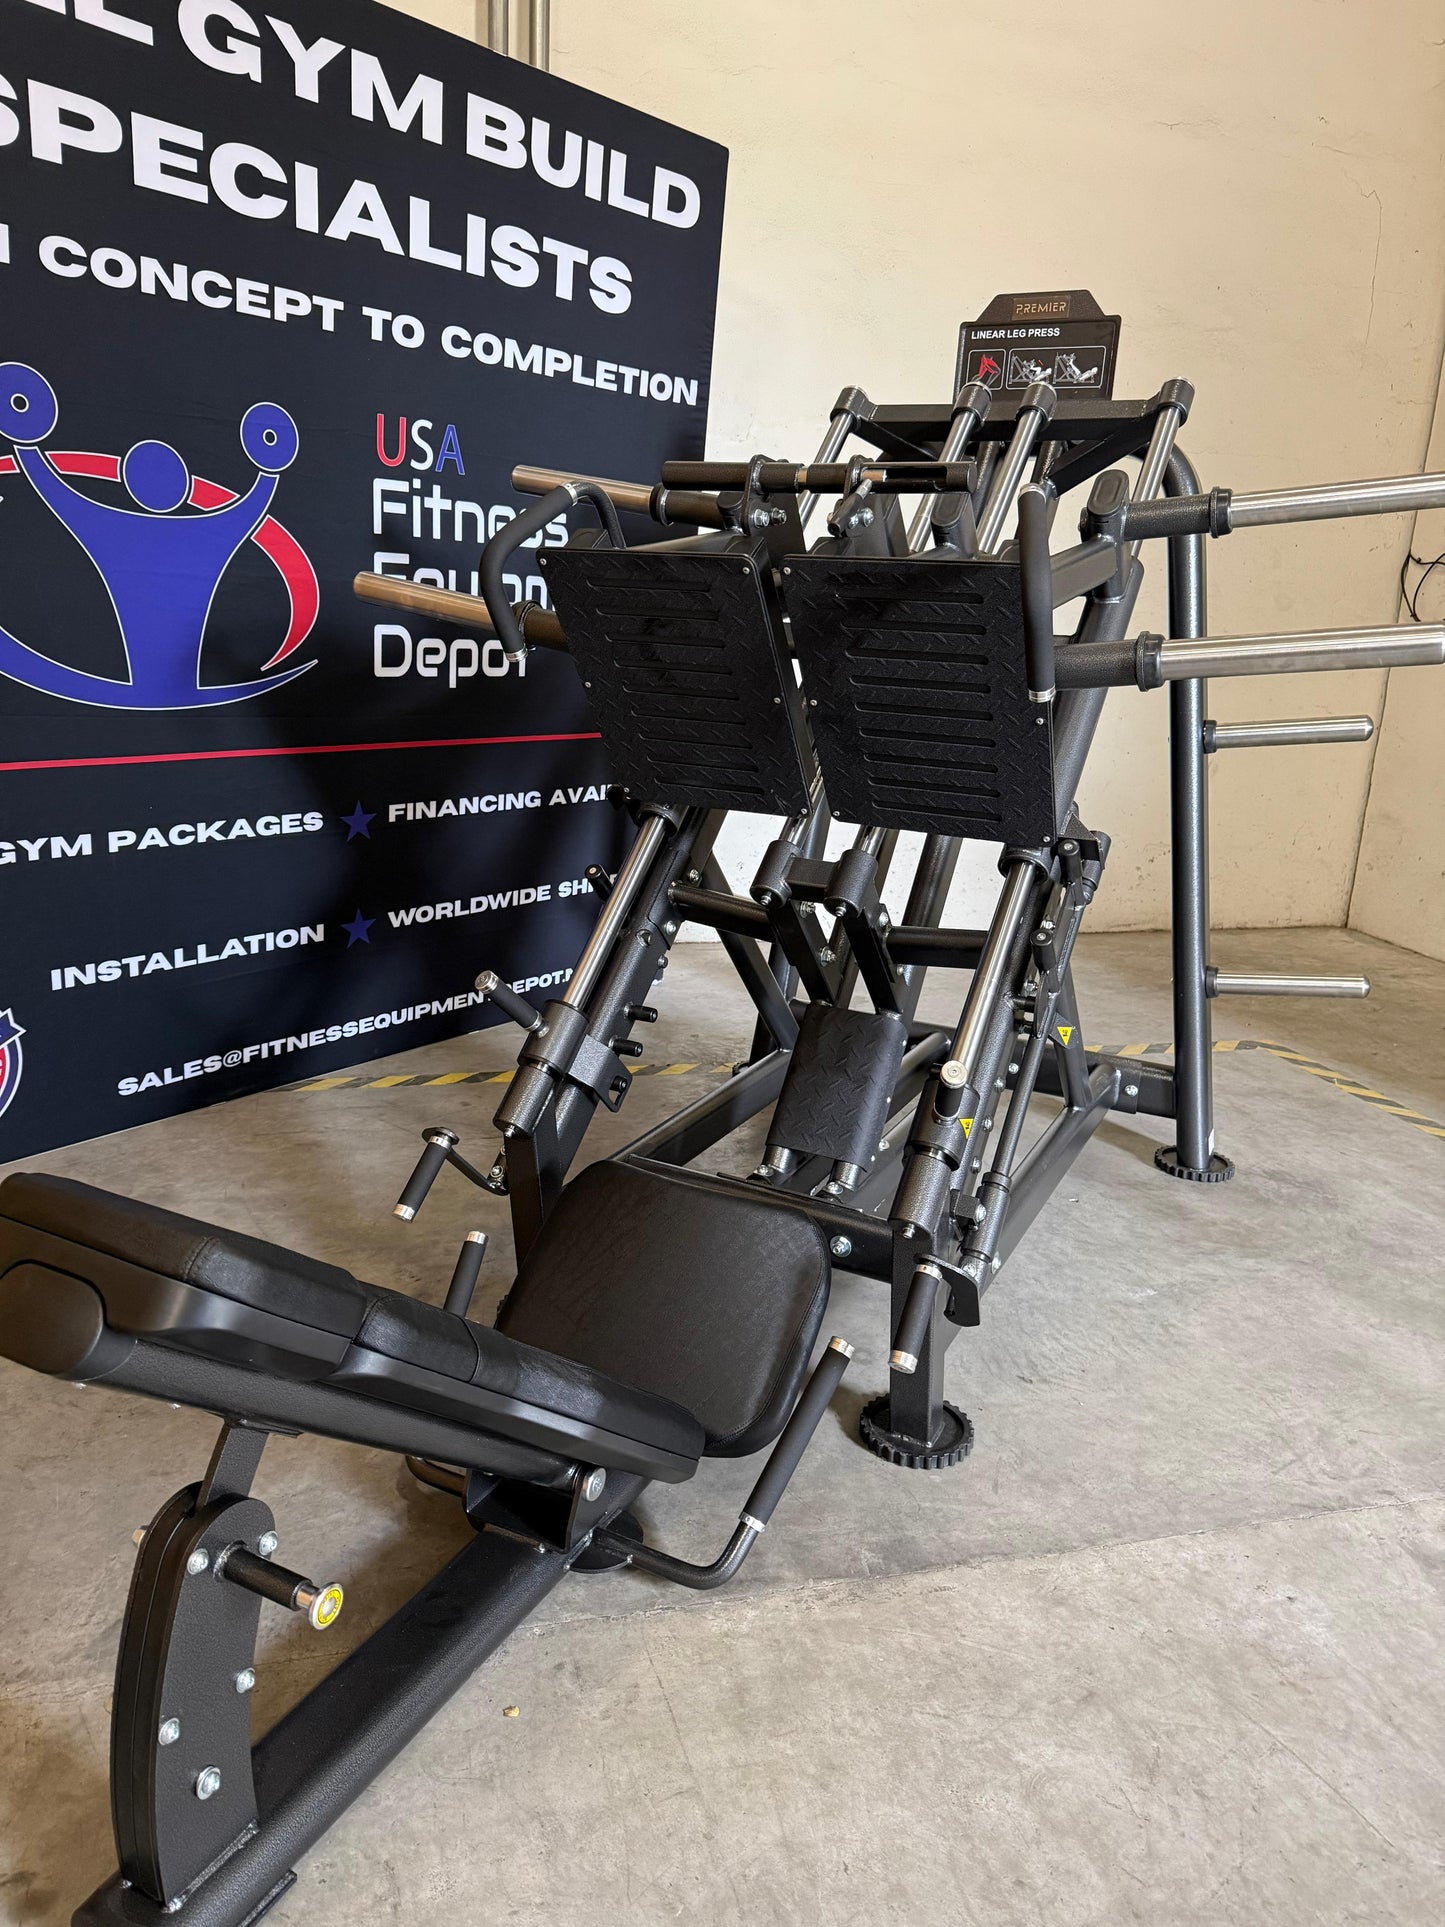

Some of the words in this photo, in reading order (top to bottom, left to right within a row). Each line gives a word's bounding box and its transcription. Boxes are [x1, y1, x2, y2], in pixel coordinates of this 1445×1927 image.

[177, 0, 444, 146] GYM
[466, 92, 701, 229] BUILD
[0, 74, 633, 315] PECIALISTS
[38, 235, 345, 332] CONCEPT
[361, 305, 425, 349] TO
[441, 325, 699, 407] COMPLETION
[971, 330, 1005, 340] LINEAR
[1007, 329, 1026, 339] LEG
[1028, 328, 1060, 338] PRESS
[1016, 302, 1067, 314] PREMIER
[376, 413, 466, 476] USA
[107, 811, 324, 853] PACKAGES
[388, 790, 542, 823] FINANCING
[387, 884, 552, 928] WORLDWIDE
[51, 924, 325, 991] INSTALLATION
